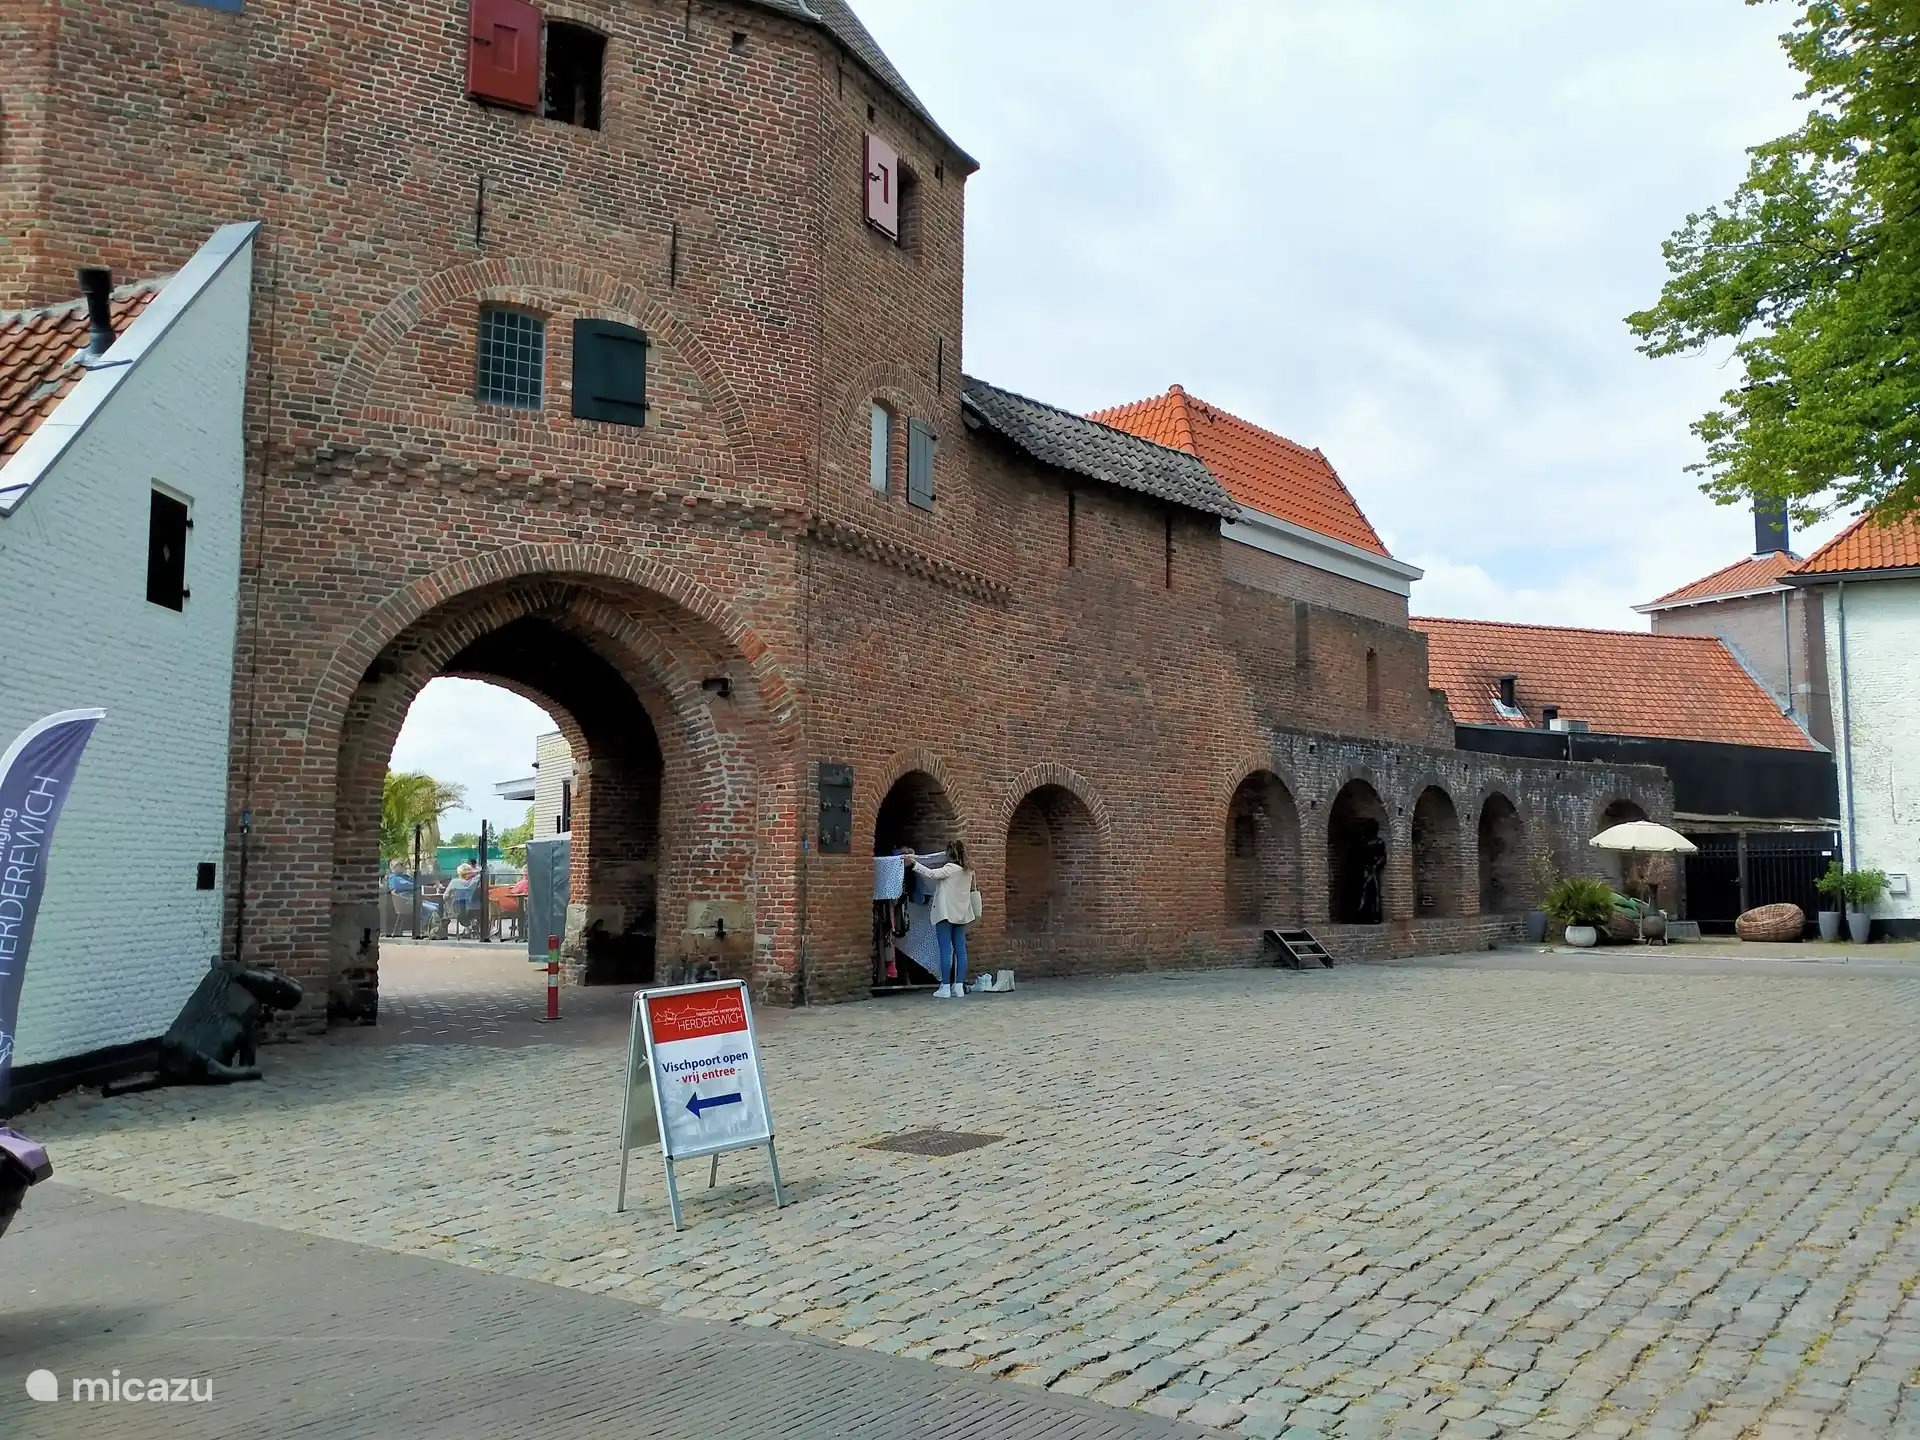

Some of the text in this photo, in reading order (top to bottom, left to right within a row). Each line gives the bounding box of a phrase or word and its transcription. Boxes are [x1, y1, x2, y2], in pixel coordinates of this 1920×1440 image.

[678, 1012, 744, 1031] HERDEREWICH
[662, 1052, 749, 1073] Vischpoort open
[682, 1071, 700, 1084] vrij
[702, 1067, 736, 1080] entree
